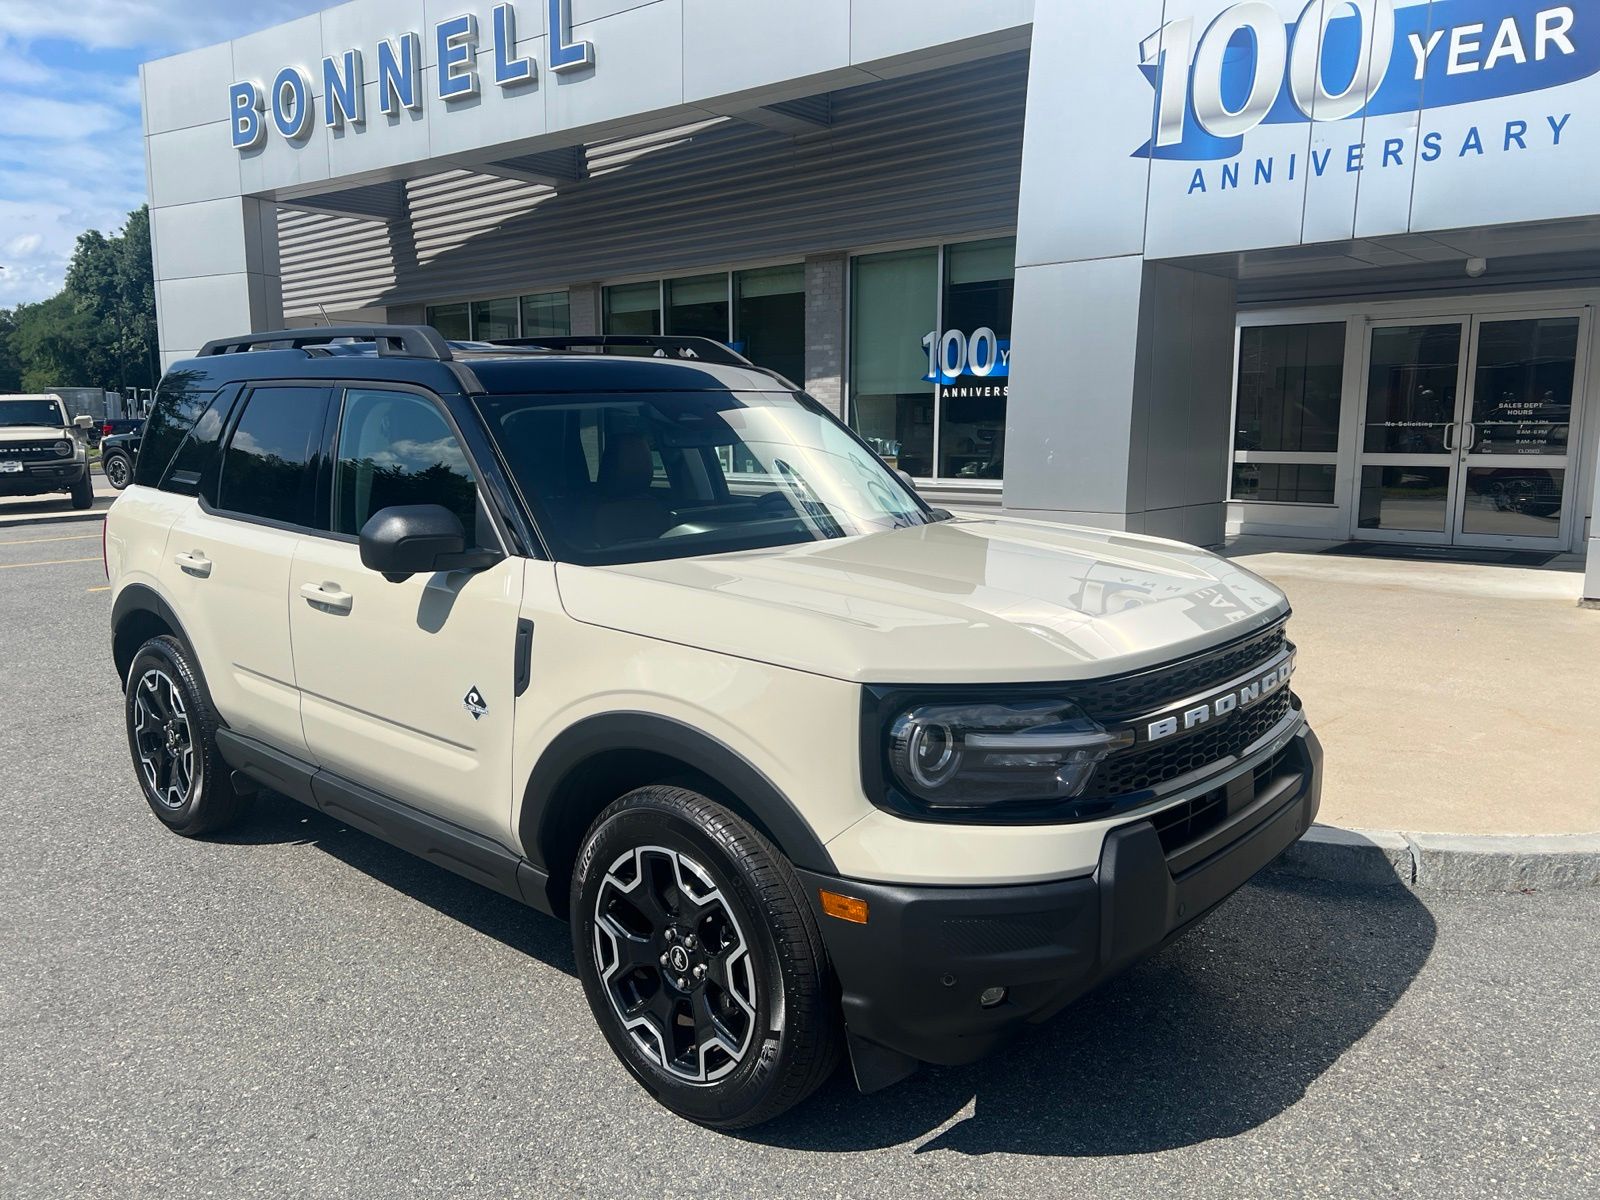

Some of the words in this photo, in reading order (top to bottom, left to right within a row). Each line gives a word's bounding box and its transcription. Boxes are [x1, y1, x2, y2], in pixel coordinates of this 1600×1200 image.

[228, 0, 591, 149] BONNELL
[1138, 0, 1395, 147] 100
[1407, 6, 1576, 81] YEAR
[1187, 113, 1571, 195] ANNIVERSARY
[922, 326, 998, 378] 100
[1148, 661, 1292, 742] BRONCO
